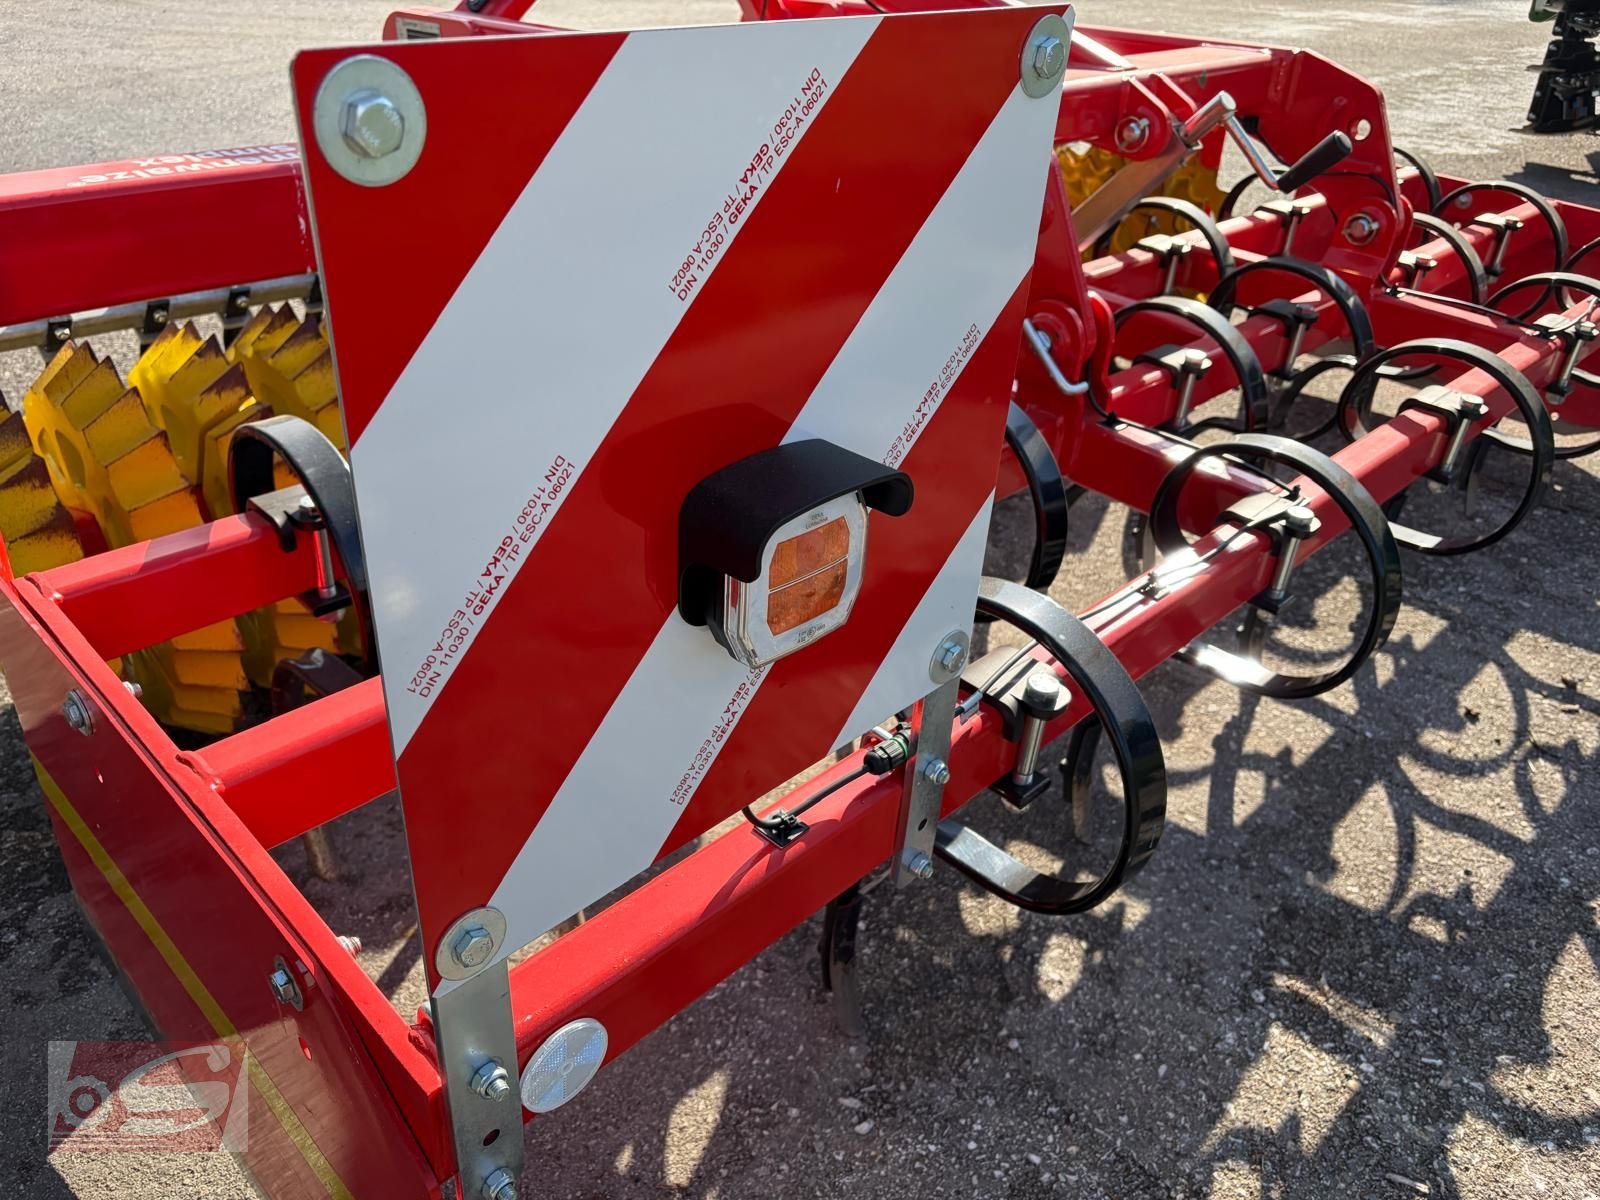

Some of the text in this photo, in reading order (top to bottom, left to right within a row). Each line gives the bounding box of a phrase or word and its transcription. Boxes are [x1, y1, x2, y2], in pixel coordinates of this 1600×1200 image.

[801, 68, 820, 96] DIN
[774, 98, 801, 135] 11030
[131, 145, 297, 167] simplex
[739, 143, 769, 184] GEKA
[678, 274, 697, 301] DIN
[697, 233, 724, 272] 11030
[728, 185, 758, 225] GEKA
[760, 155, 774, 174] TP
[774, 116, 804, 157] ESC-A
[802, 78, 827, 116] 06021
[724, 195, 736, 213] TP
[692, 212, 723, 254] ESC-A
[668, 255, 696, 293] 06021
[962, 323, 977, 344] DIN
[942, 346, 962, 375] 11030
[888, 450, 902, 467] 030
[906, 412, 928, 442] GEKA
[930, 389, 940, 403] TP
[940, 359, 963, 390] ESC-A
[961, 330, 981, 358] 06021
[915, 382, 938, 413] GEKA
[903, 422, 913, 436] TP
[544, 455, 565, 483] DIN
[517, 487, 545, 524] 11030
[481, 536, 513, 576] GEKA
[419, 671, 442, 698] DIN
[440, 627, 469, 666] 11030
[472, 576, 505, 616] GEKA
[505, 544, 520, 562] TP
[519, 503, 552, 543] ESC-A
[548, 462, 575, 500] 06021
[465, 592, 480, 608] TP
[432, 610, 466, 652] ESC-A
[406, 655, 437, 693] 06021
[723, 682, 746, 714] GEKA
[677, 784, 692, 805] DIN
[692, 751, 712, 780] 11030
[716, 711, 738, 743] GEKA
[740, 688, 750, 700] TP
[750, 664, 766, 687] ESC
[712, 725, 722, 738] TP
[688, 739, 712, 771] ESC-A
[670, 773, 690, 802] 06021
